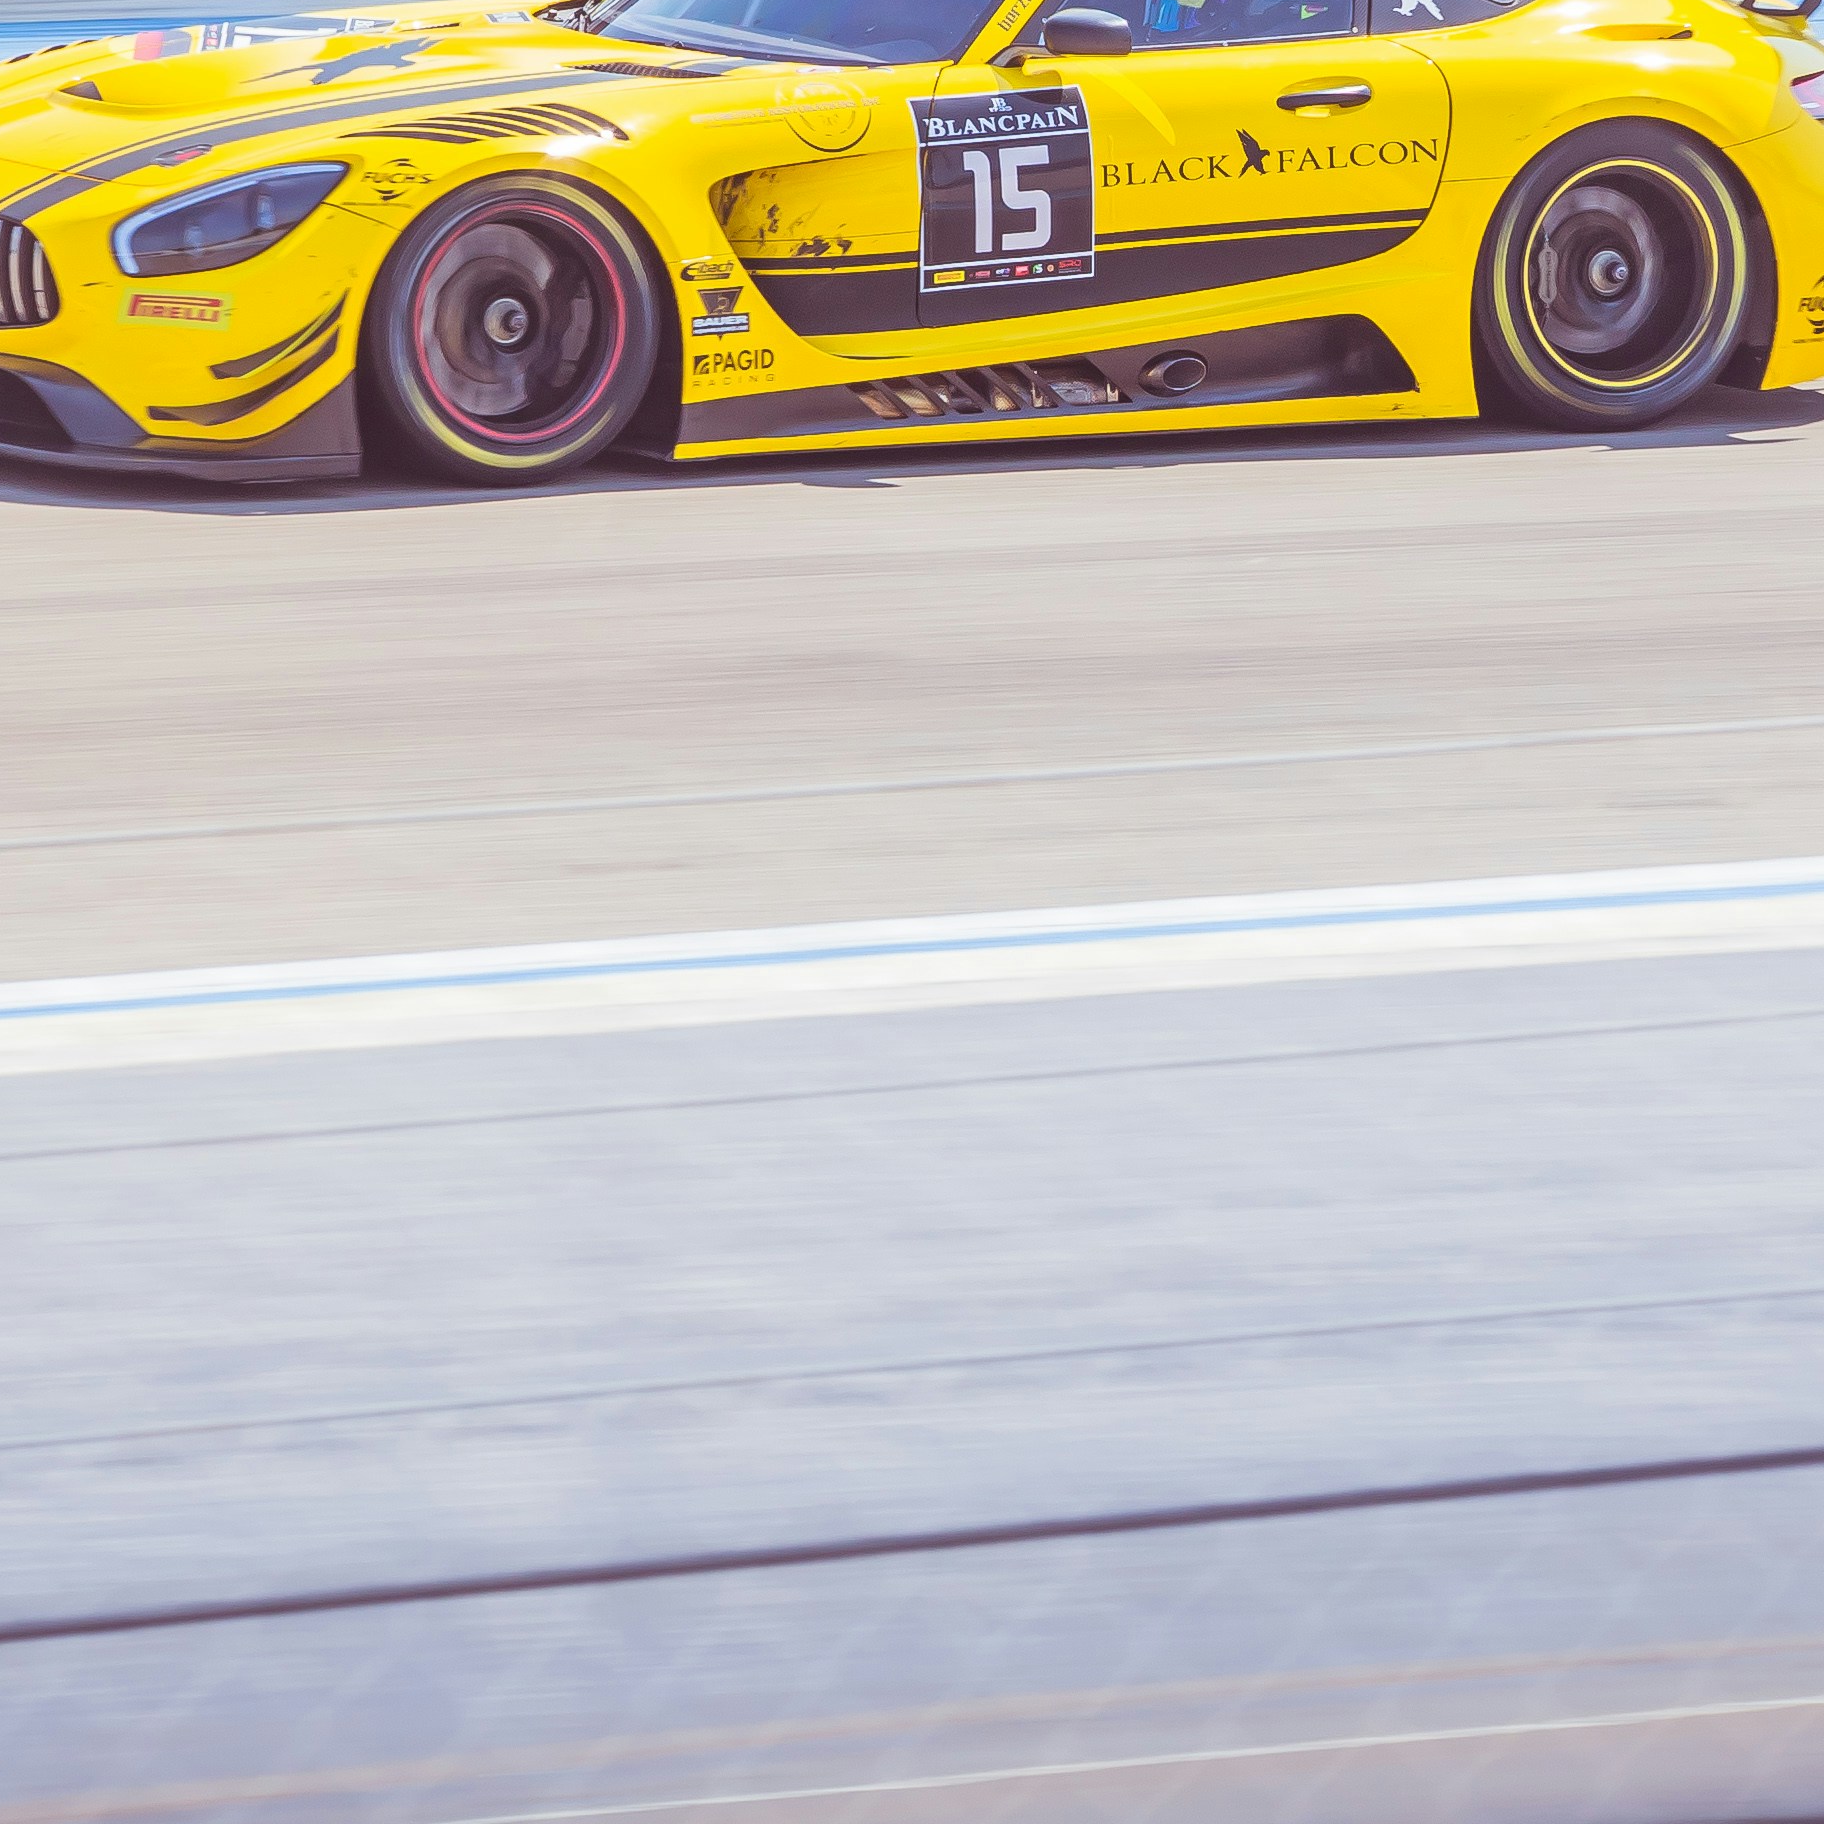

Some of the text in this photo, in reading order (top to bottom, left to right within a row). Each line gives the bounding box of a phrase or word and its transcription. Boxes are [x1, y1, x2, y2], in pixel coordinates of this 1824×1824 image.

[923, 105, 1079, 138] BLANCPAIN
[1101, 138, 1439, 188] BLACK FALCON
[962, 144, 1052, 254] 15
[128, 293, 222, 323] PIRELLI
[713, 348, 775, 374] PAGID
